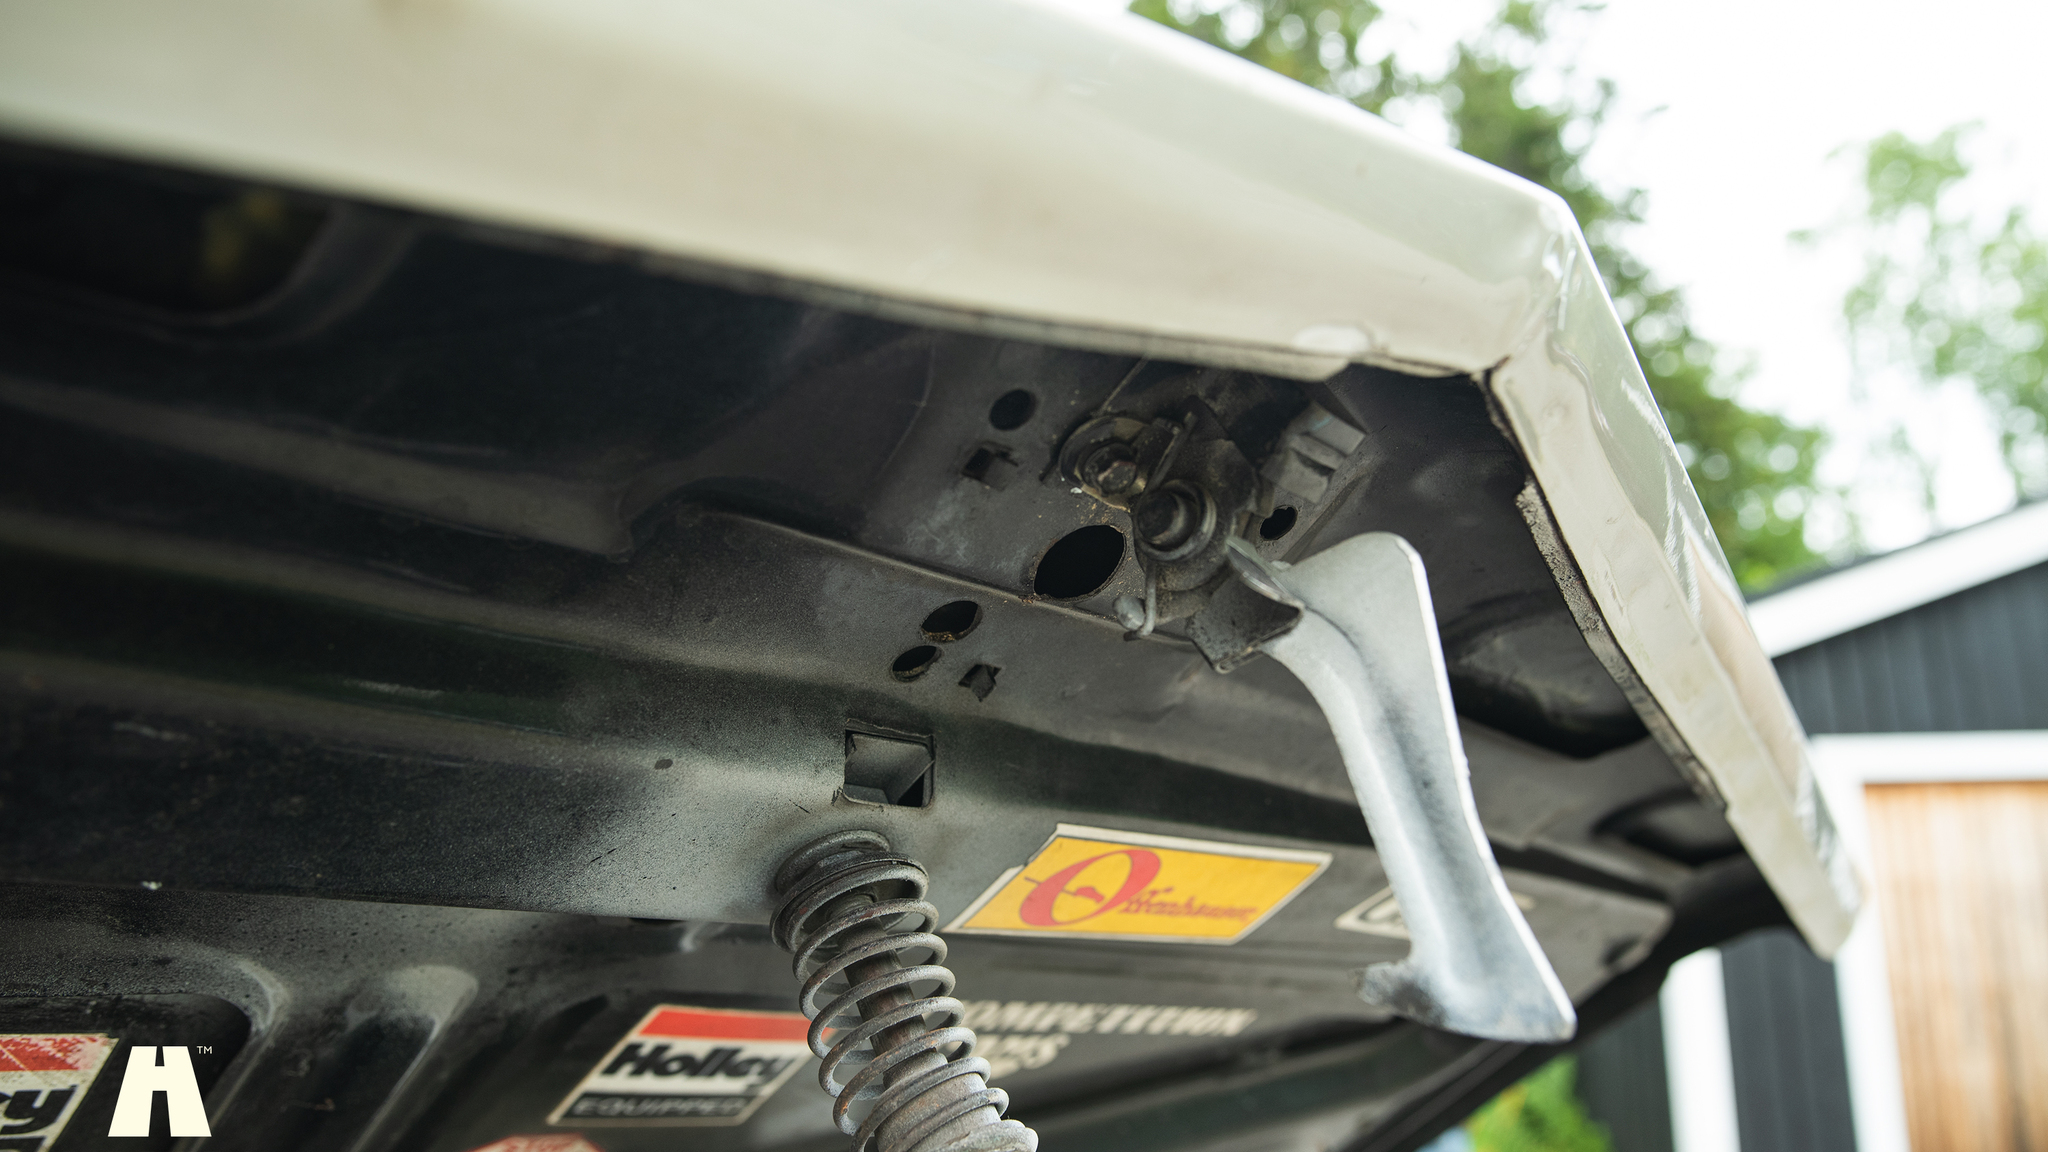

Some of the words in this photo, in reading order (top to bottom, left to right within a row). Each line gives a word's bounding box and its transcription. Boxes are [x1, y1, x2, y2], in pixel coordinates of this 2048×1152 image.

[956, 1000, 1256, 1037] OMPETITION
[601, 1043, 796, 1094] Holley
[570, 1096, 749, 1117] EQUIPPED
